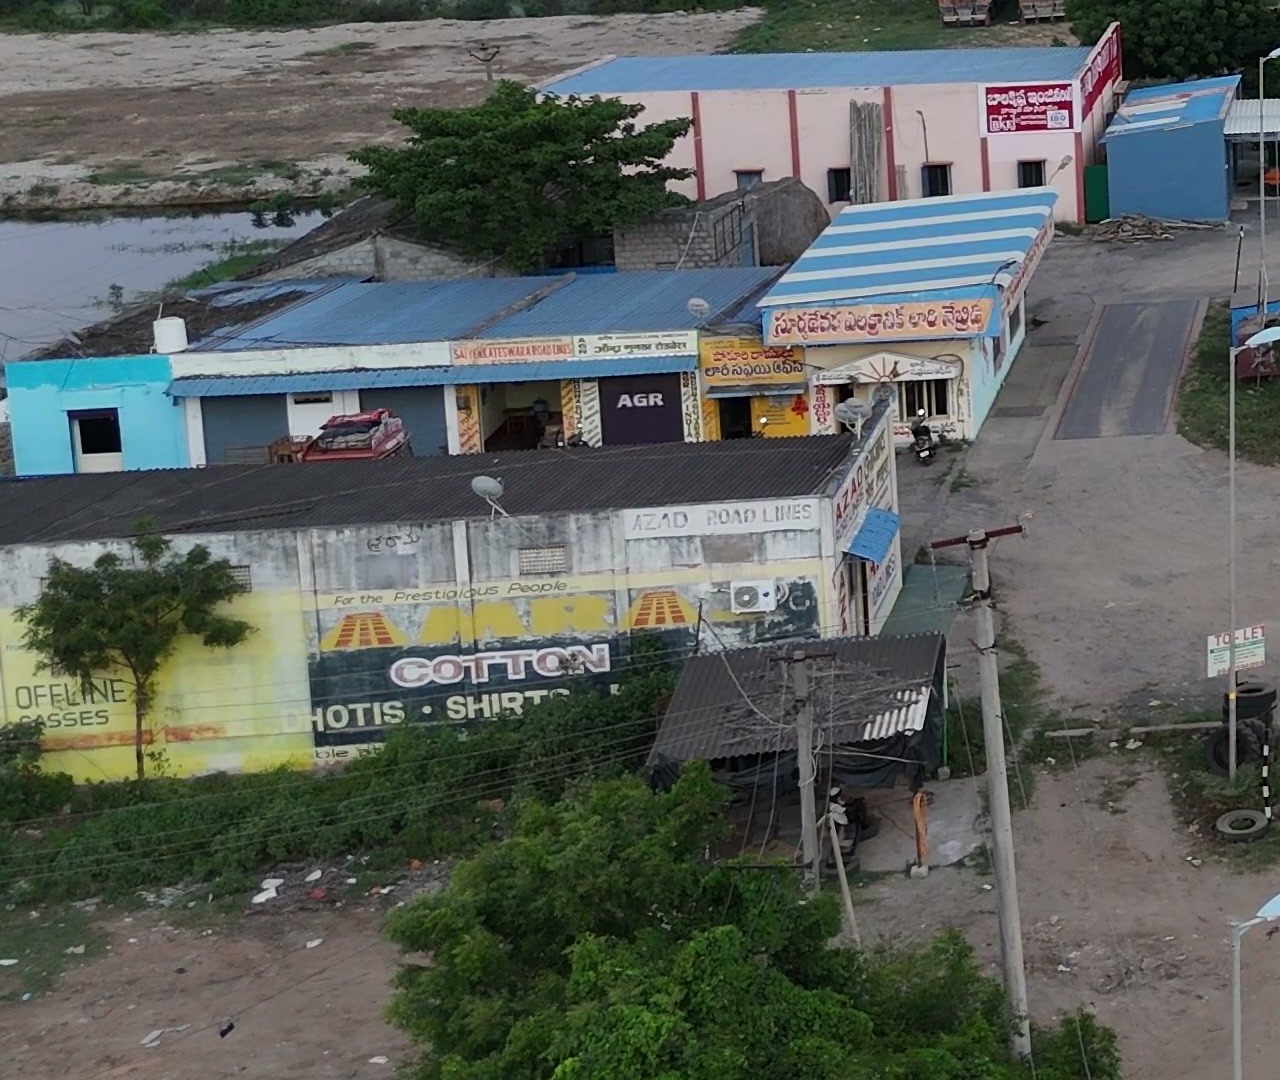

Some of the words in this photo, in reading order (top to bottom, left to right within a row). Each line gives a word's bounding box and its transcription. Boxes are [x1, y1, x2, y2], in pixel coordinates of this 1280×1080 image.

[617, 393, 664, 409] AGR
[834, 465, 863, 525] AZAD
[632, 511, 689, 531] AZAD
[707, 507, 757, 526] ROAD
[763, 504, 812, 523] LINES
[334, 595, 355, 606] For
[360, 593, 384, 604] the
[1243, 625, 1265, 641] LET
[390, 643, 611, 688] COTTON
[15, 678, 128, 710] OFFLINE
